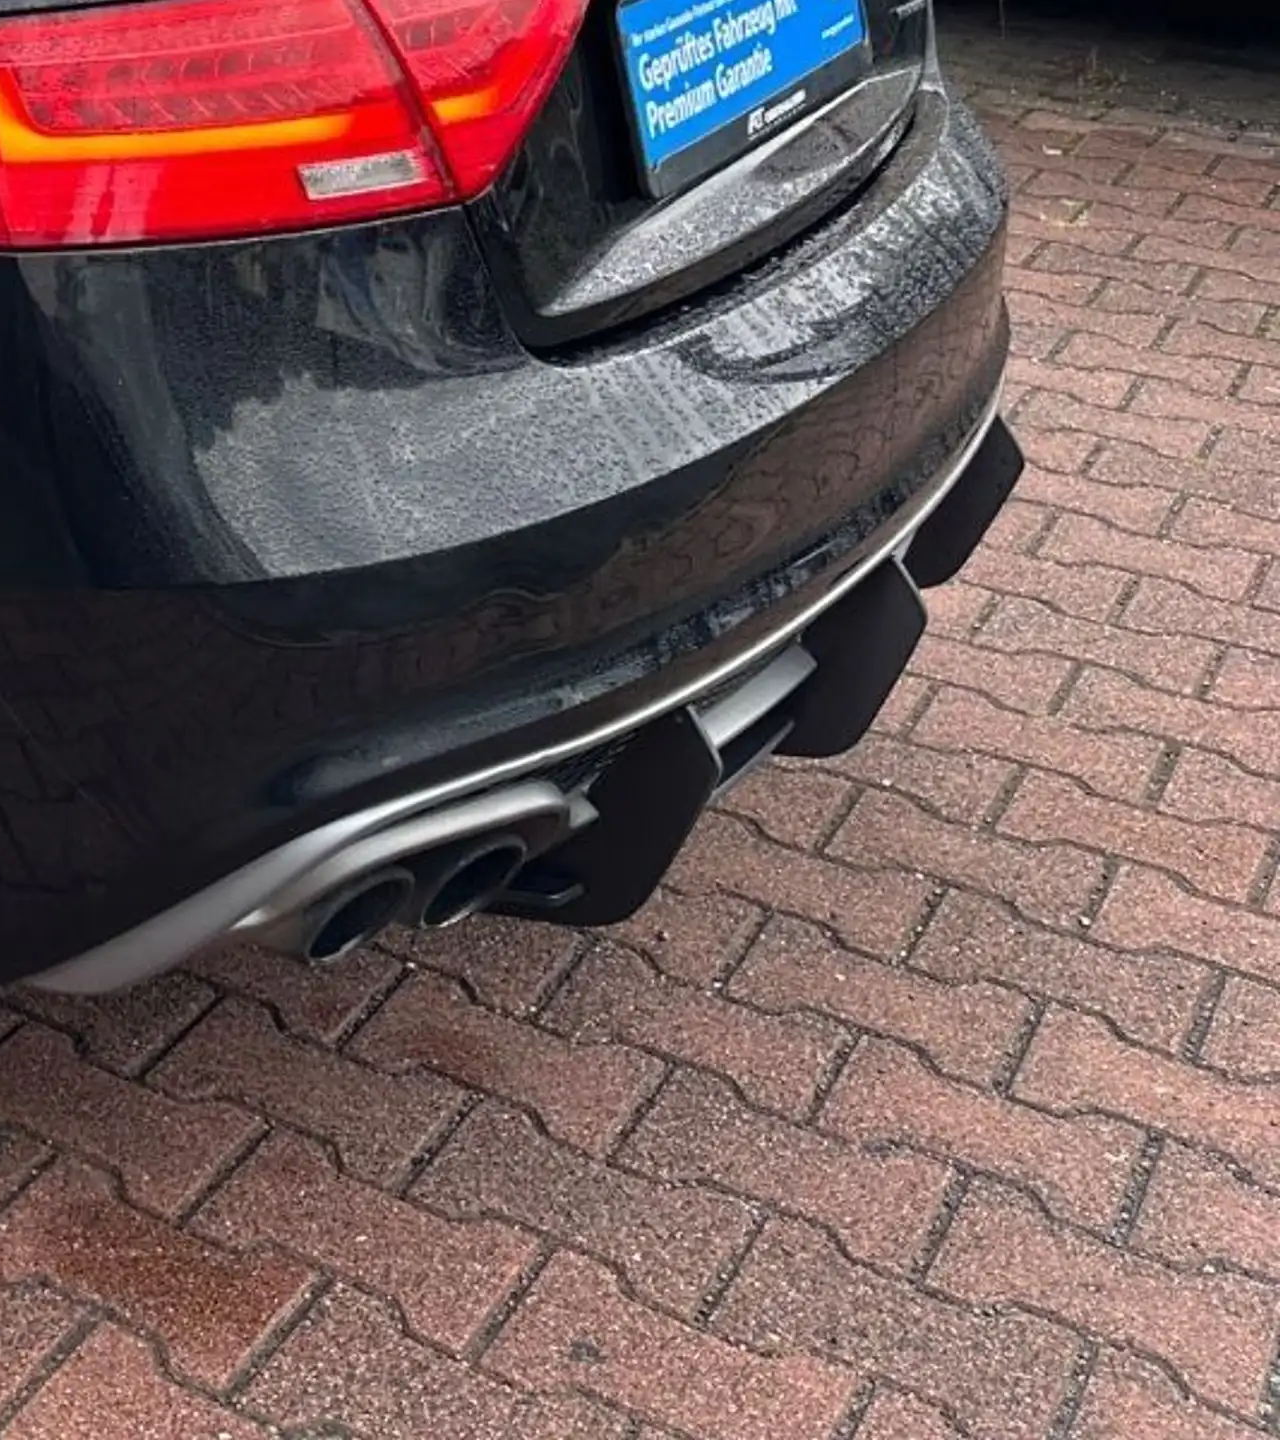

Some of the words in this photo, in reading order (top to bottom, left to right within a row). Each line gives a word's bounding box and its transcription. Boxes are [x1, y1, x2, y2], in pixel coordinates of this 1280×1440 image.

[639, 31, 716, 92] Geprüftes
[712, 0, 776, 53] Fahrzeug
[645, 80, 717, 139] Premium
